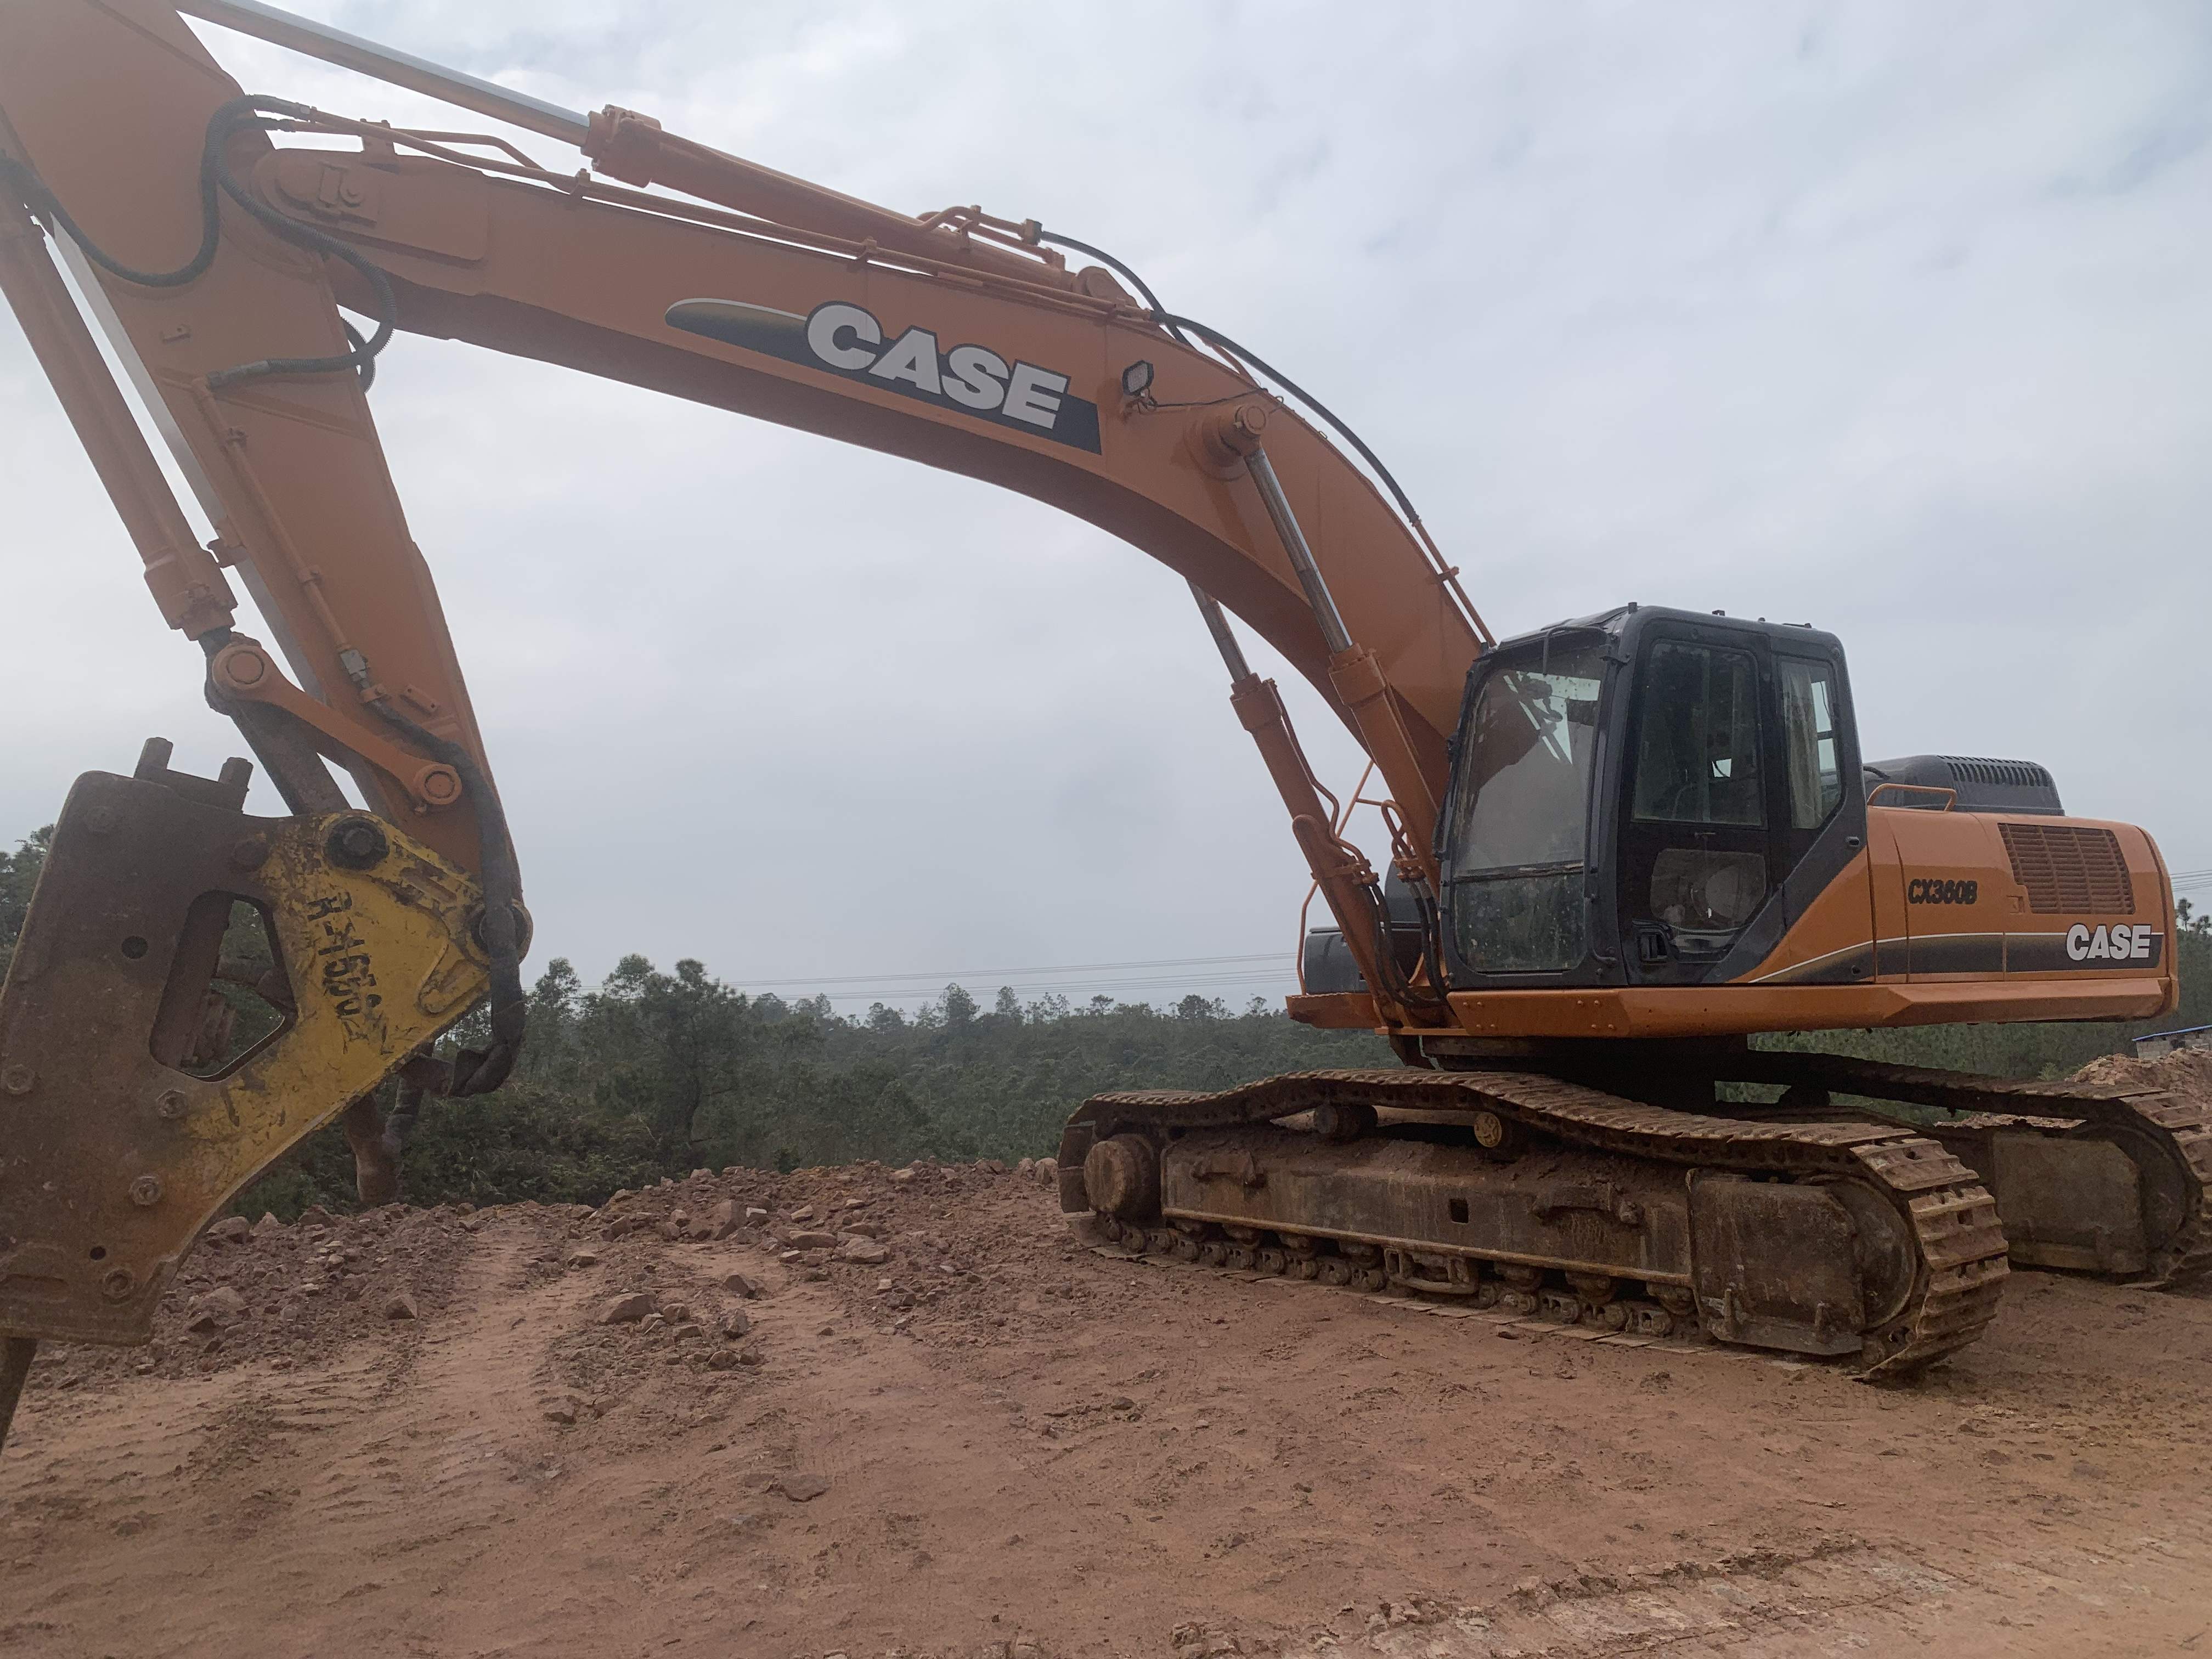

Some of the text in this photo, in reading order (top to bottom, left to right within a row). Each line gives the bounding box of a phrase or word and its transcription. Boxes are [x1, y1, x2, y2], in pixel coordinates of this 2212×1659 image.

[807, 304, 1069, 429] CASE
[1908, 878, 1978, 904] CX360B
[2066, 924, 2151, 961] CASE
